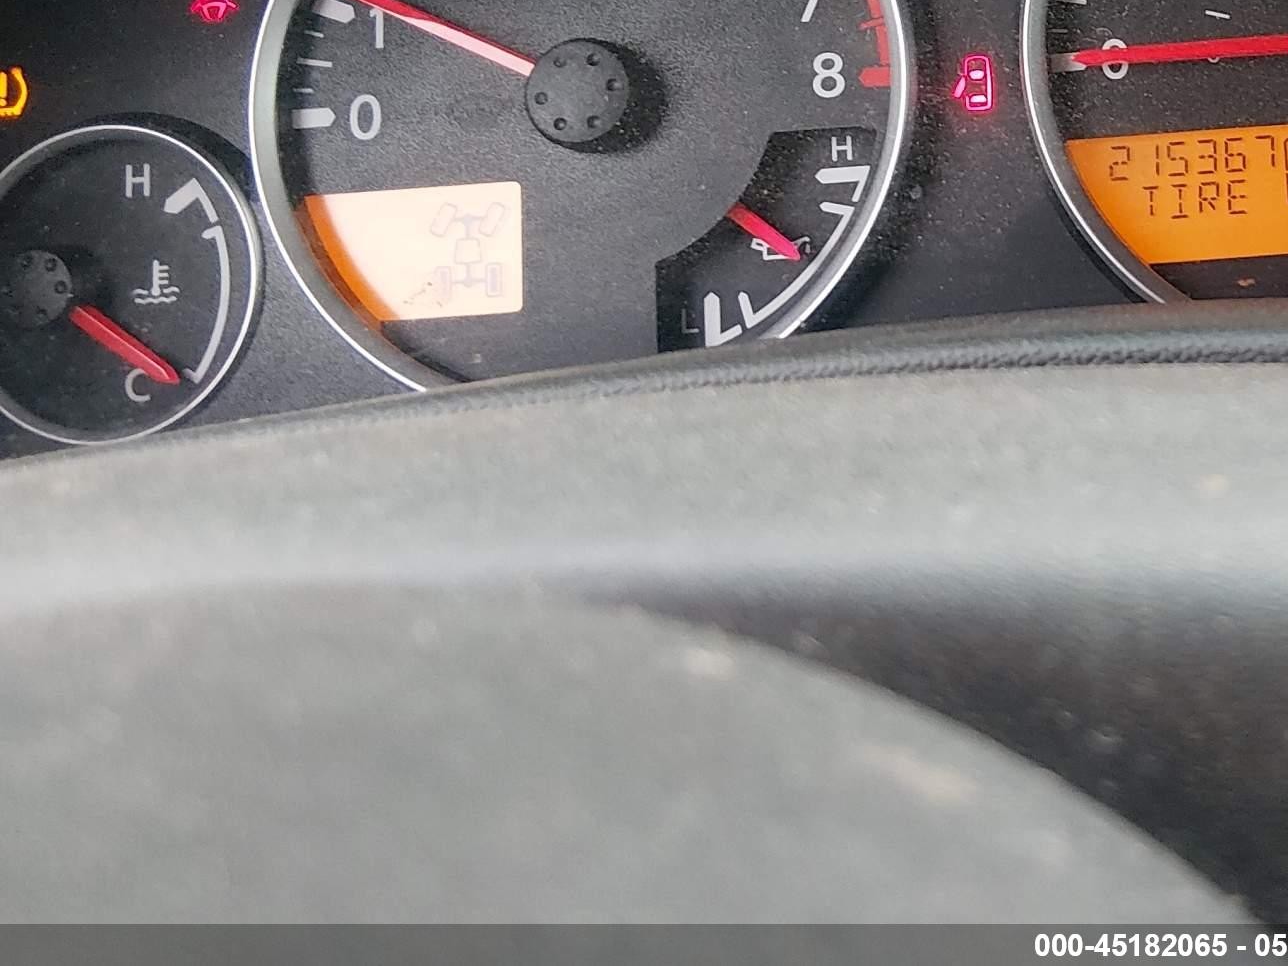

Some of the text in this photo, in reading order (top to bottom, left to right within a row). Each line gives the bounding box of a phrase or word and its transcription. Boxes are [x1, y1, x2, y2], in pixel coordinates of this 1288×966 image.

[369, 8, 386, 49] 1
[812, 52, 845, 98] 8
[1101, 38, 1129, 80] 0
[349, 94, 382, 141] 0
[831, 137, 854, 162] H
[1109, 136, 1278, 181] 215367
[125, 163, 151, 198] H
[1143, 181, 1249, 219] TIRE
[682, 312, 700, 334] L
[125, 369, 151, 402] C
